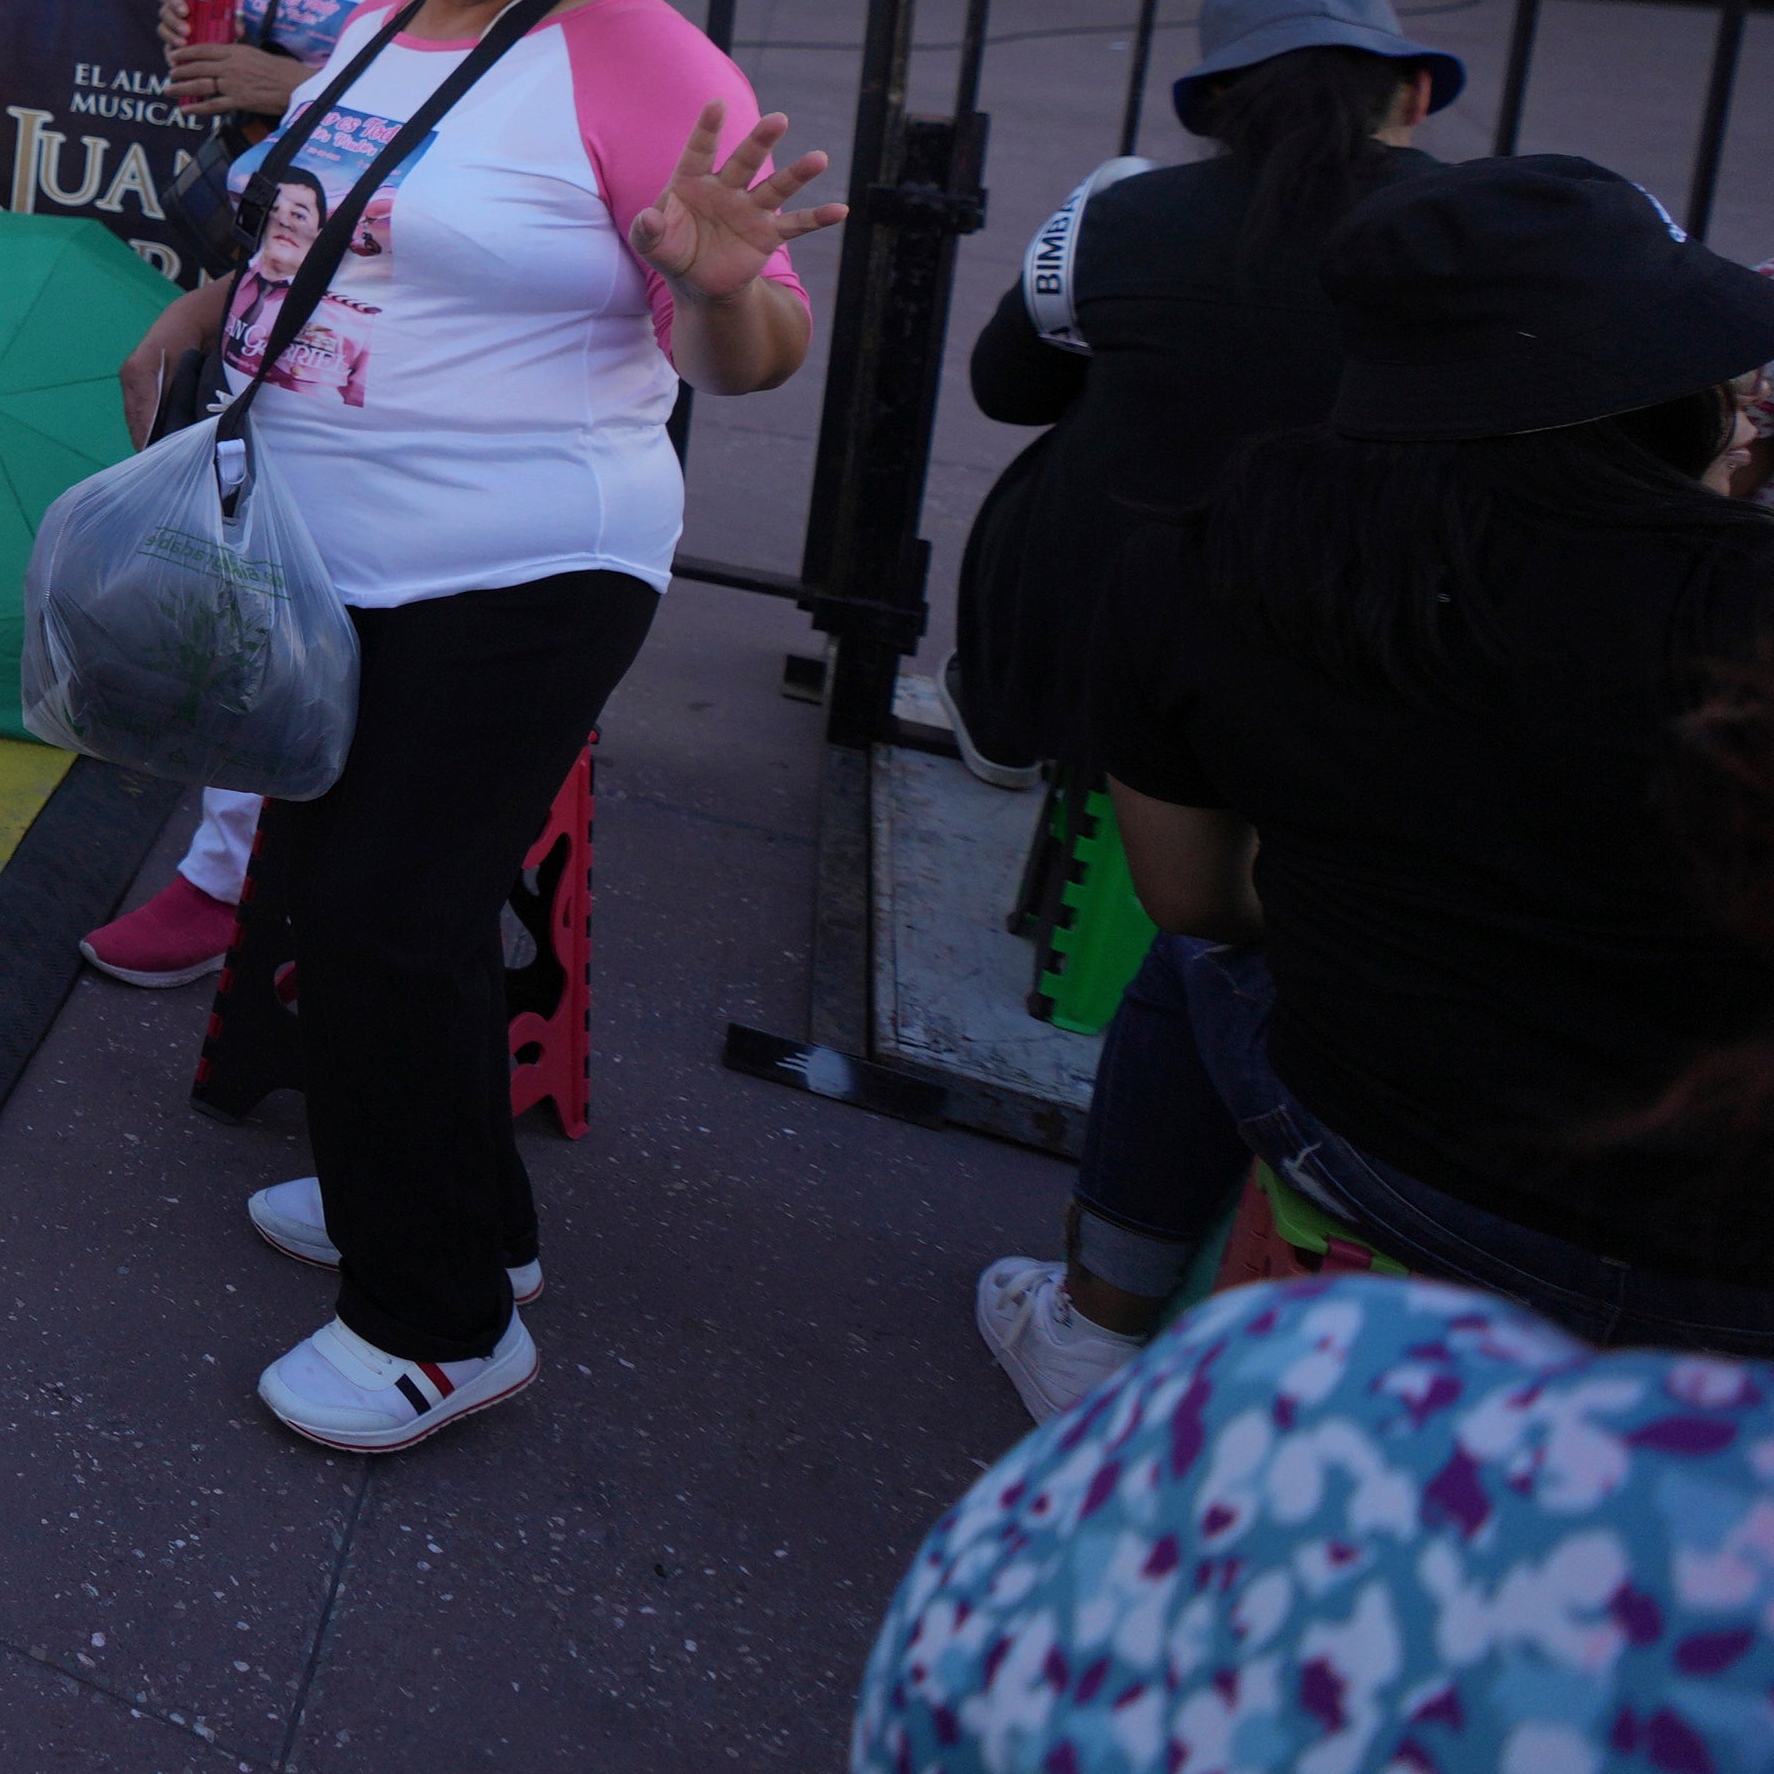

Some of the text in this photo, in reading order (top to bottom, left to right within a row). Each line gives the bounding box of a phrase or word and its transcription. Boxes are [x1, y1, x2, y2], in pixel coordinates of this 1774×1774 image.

[75, 63, 172, 95] EL ALM
[70, 92, 203, 131] MUSICAL
[362, 117, 405, 144] Tod
